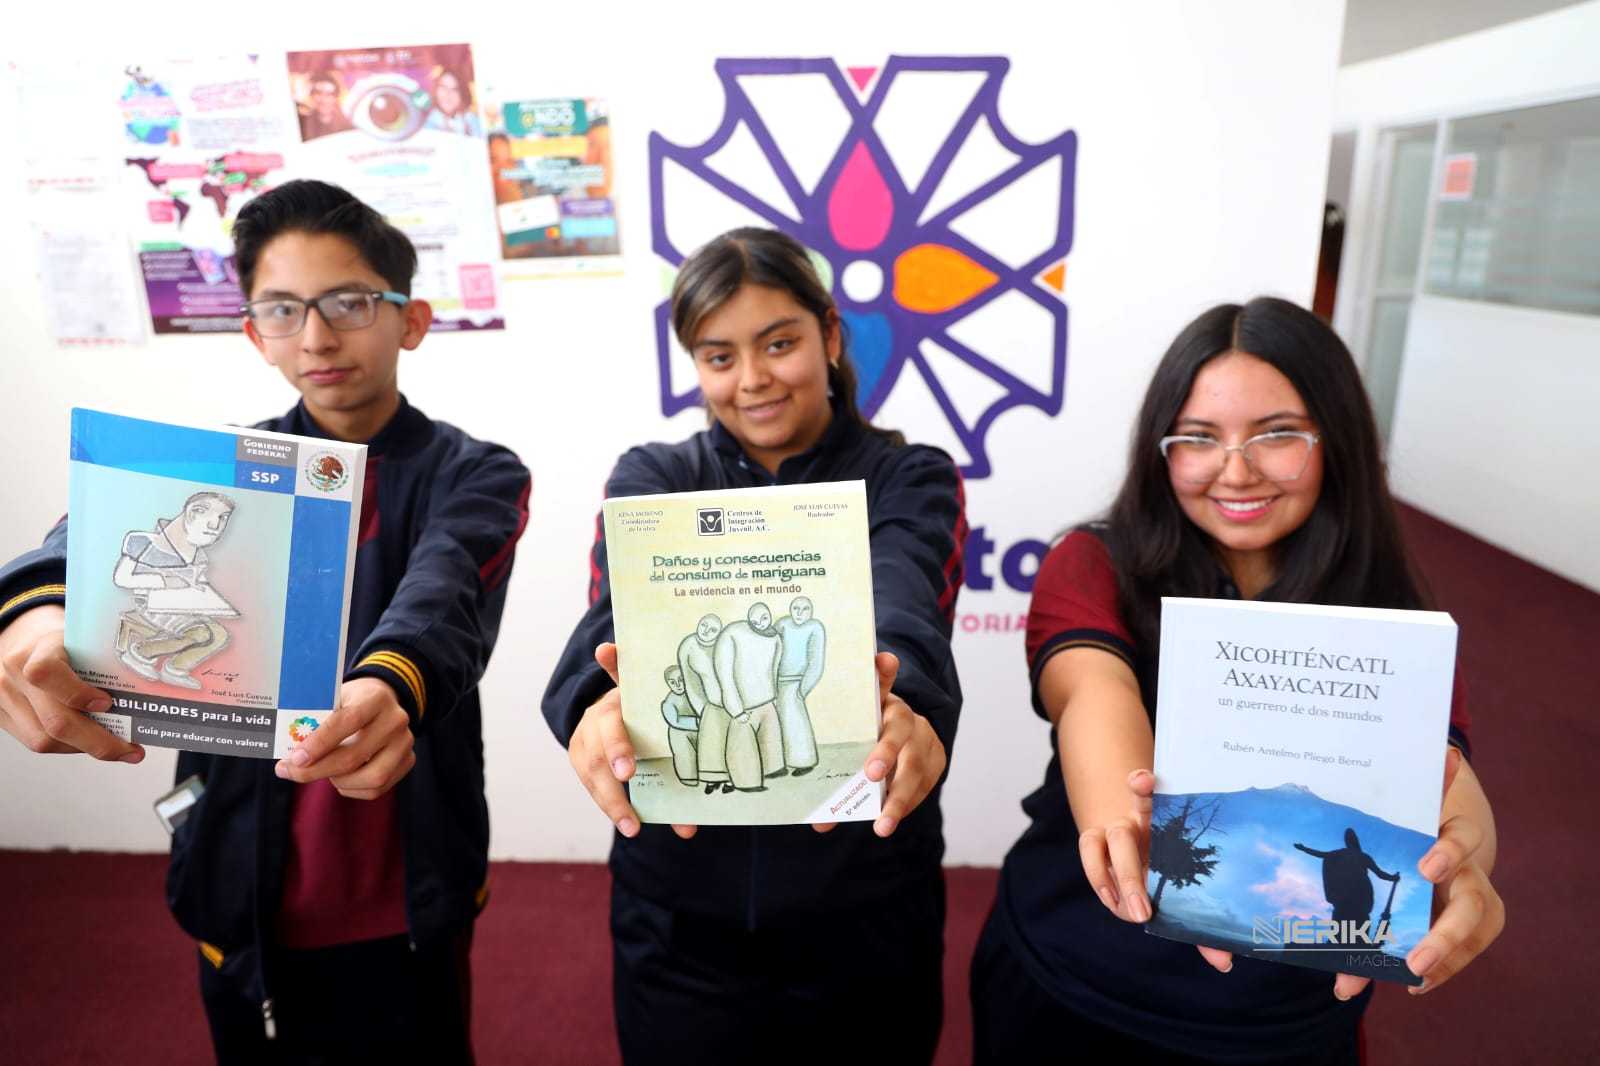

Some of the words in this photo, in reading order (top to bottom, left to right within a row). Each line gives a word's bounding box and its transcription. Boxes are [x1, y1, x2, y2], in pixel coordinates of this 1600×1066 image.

[243, 438, 292, 452] GOBIERNO
[246, 447, 287, 459] FEDERAL
[251, 471, 280, 484] SSP
[728, 517, 766, 526] Integración
[652, 554, 699, 568] Daños
[702, 557, 712, 571] y
[714, 550, 822, 565] consecuencias
[649, 570, 665, 582] del
[667, 571, 732, 582] consumo
[734, 569, 749, 580] de
[751, 566, 826, 583] mariguana
[674, 587, 687, 597] La
[689, 585, 735, 597] evidencia
[738, 586, 751, 596] en
[753, 585, 763, 595] el
[766, 584, 802, 594] mundo
[958, 612, 1028, 633] ORIA
[1215, 640, 1395, 676] XICOHTÉNCATL
[1223, 668, 1381, 700] AXAYACATZIN
[111, 697, 199, 718] ABILIDADES
[202, 711, 229, 722] para
[231, 712, 242, 723] la
[245, 714, 271, 726] vida
[1217, 697, 1233, 707] un
[1236, 699, 1288, 714] guerrero
[1290, 703, 1305, 715] de
[1307, 705, 1330, 718] dos
[1332, 709, 1384, 723] mundos
[160, 729, 181, 738] para
[182, 731, 215, 743] educar
[216, 737, 233, 745] con
[235, 738, 269, 749] valores
[1223, 740, 1255, 753] Rubén
[1257, 746, 1301, 760] Antelmo
[1303, 751, 1335, 766] Pliego
[1338, 755, 1372, 768] Bernal
